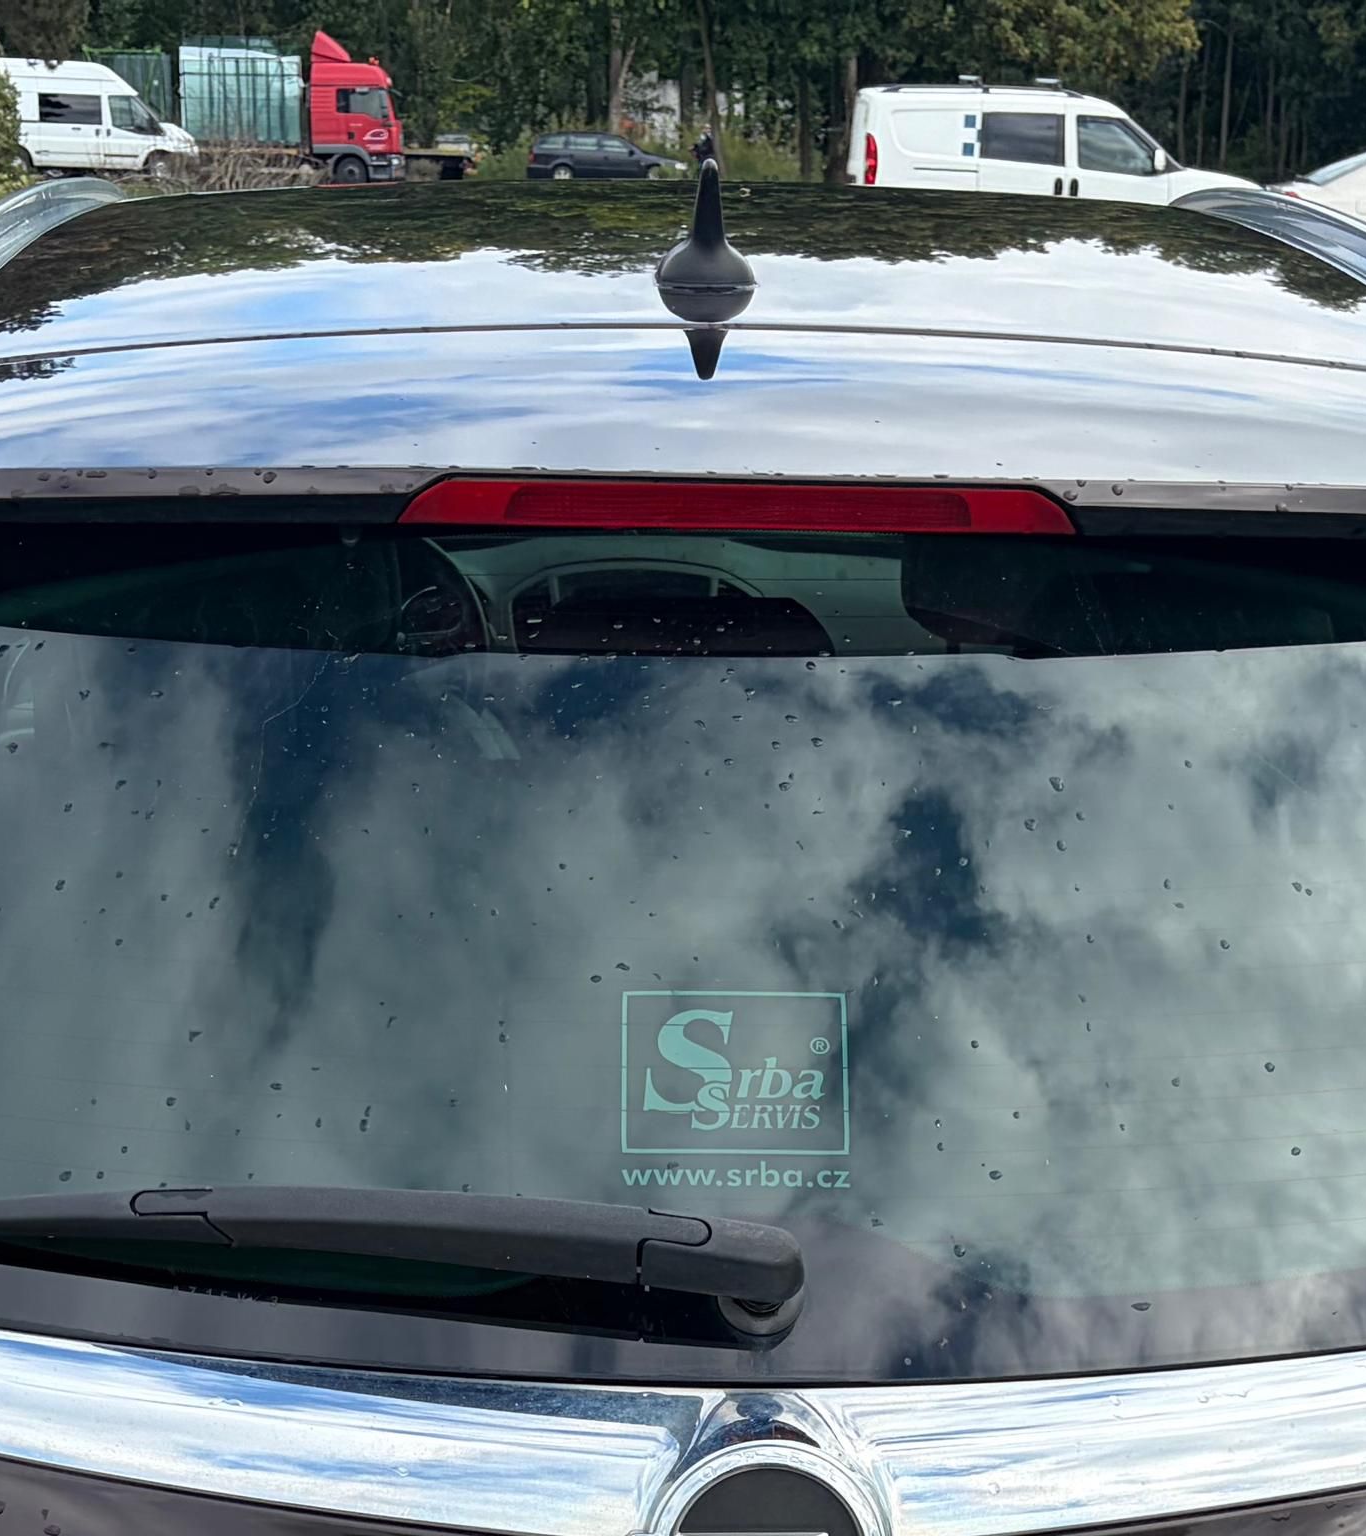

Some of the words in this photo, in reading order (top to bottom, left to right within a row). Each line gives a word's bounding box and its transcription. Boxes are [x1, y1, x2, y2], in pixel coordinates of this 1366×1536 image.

[643, 1008, 826, 1115] Srba
[691, 1082, 821, 1131] SERVIS
[621, 1160, 852, 1189] www.srba.cz
